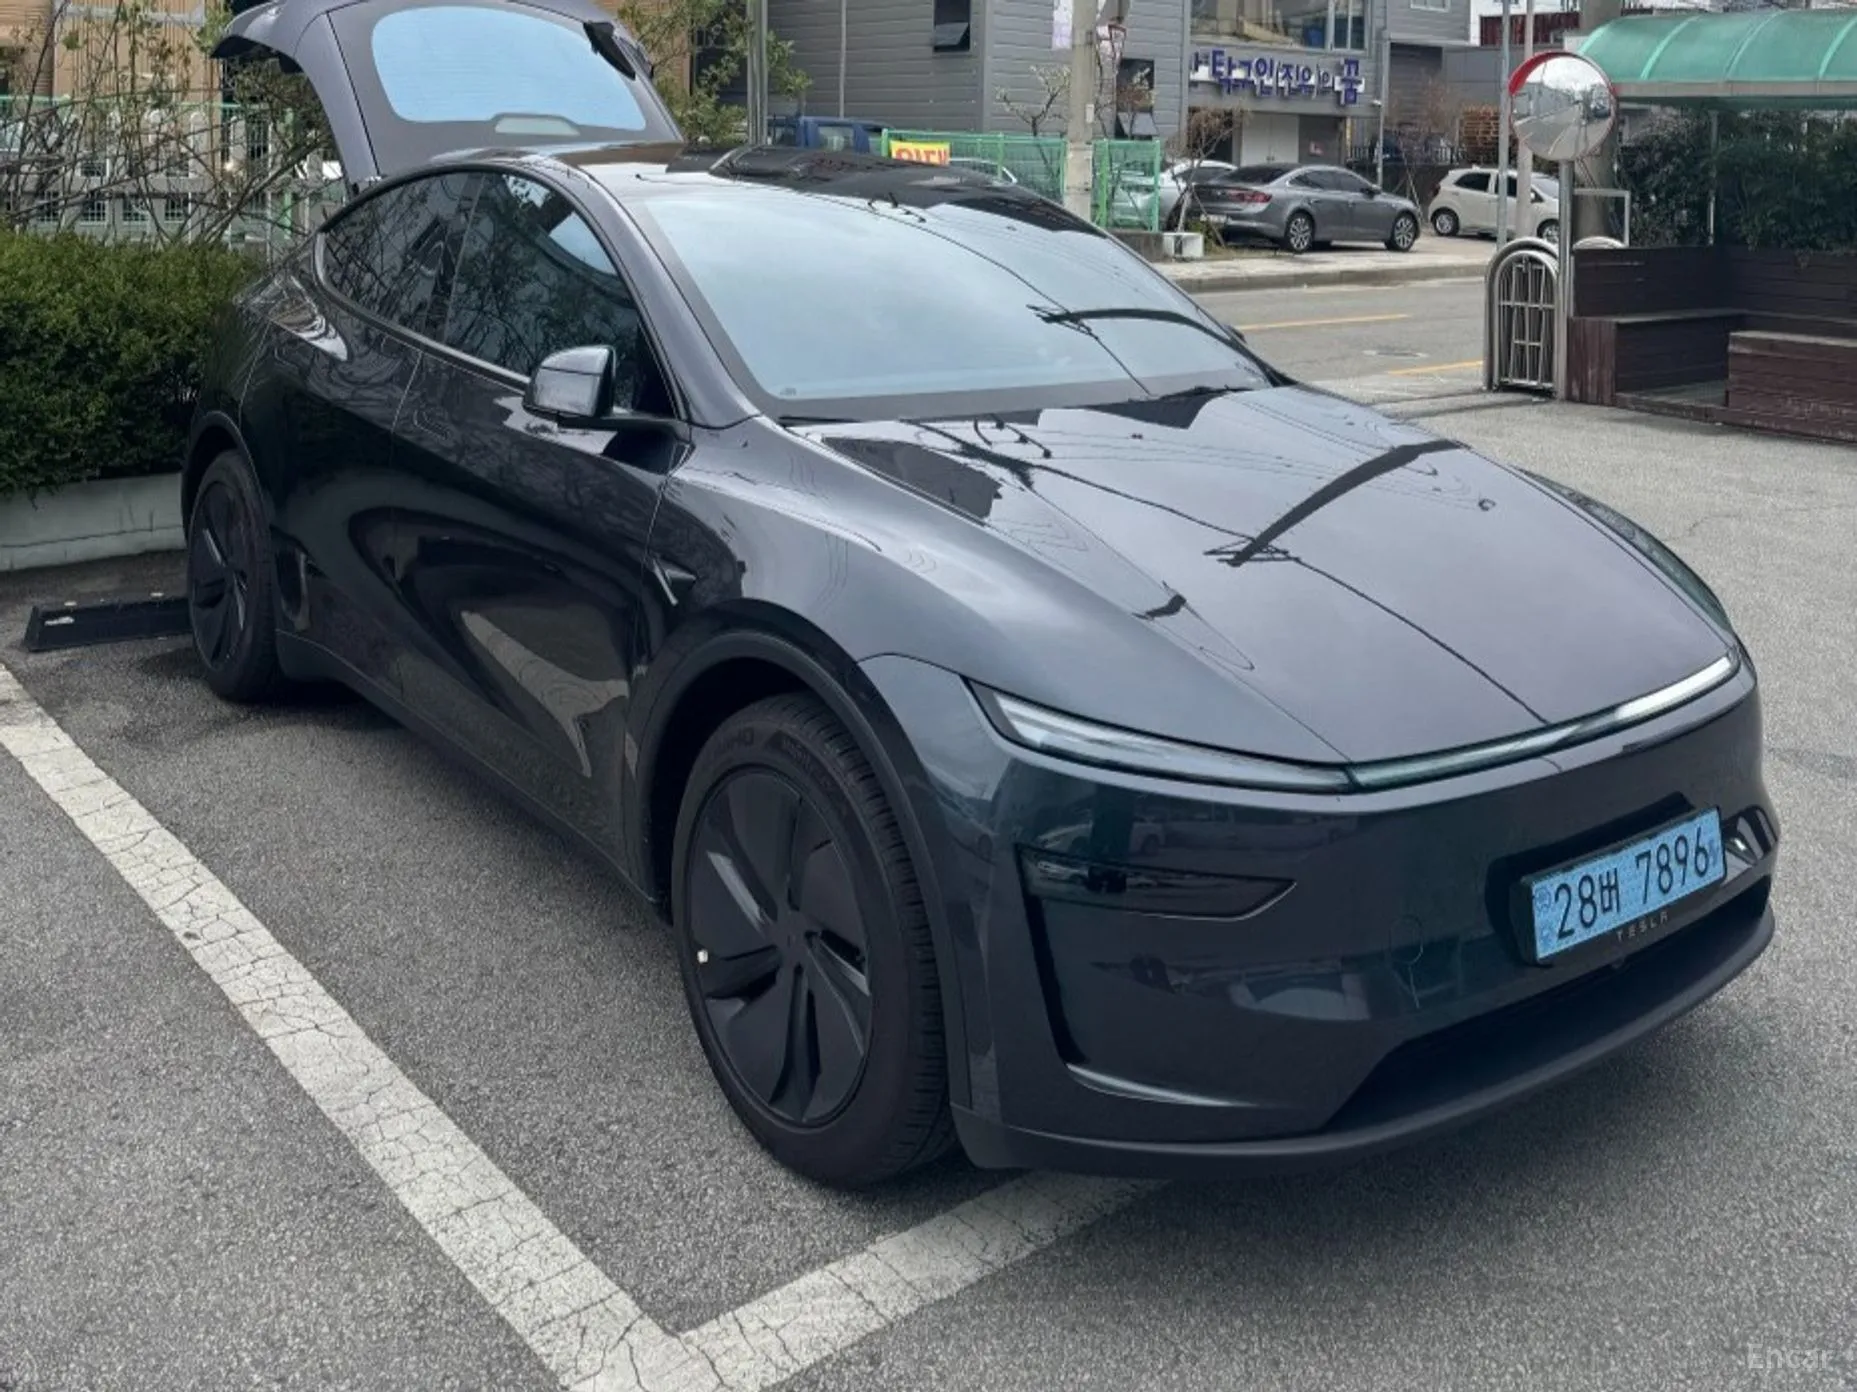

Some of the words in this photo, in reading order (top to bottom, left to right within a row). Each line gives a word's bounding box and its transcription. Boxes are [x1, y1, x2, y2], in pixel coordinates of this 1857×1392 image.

[1554, 868, 1620, 940] 28버
[1635, 827, 1709, 905] 7896
[1616, 911, 1669, 941] TESLA
